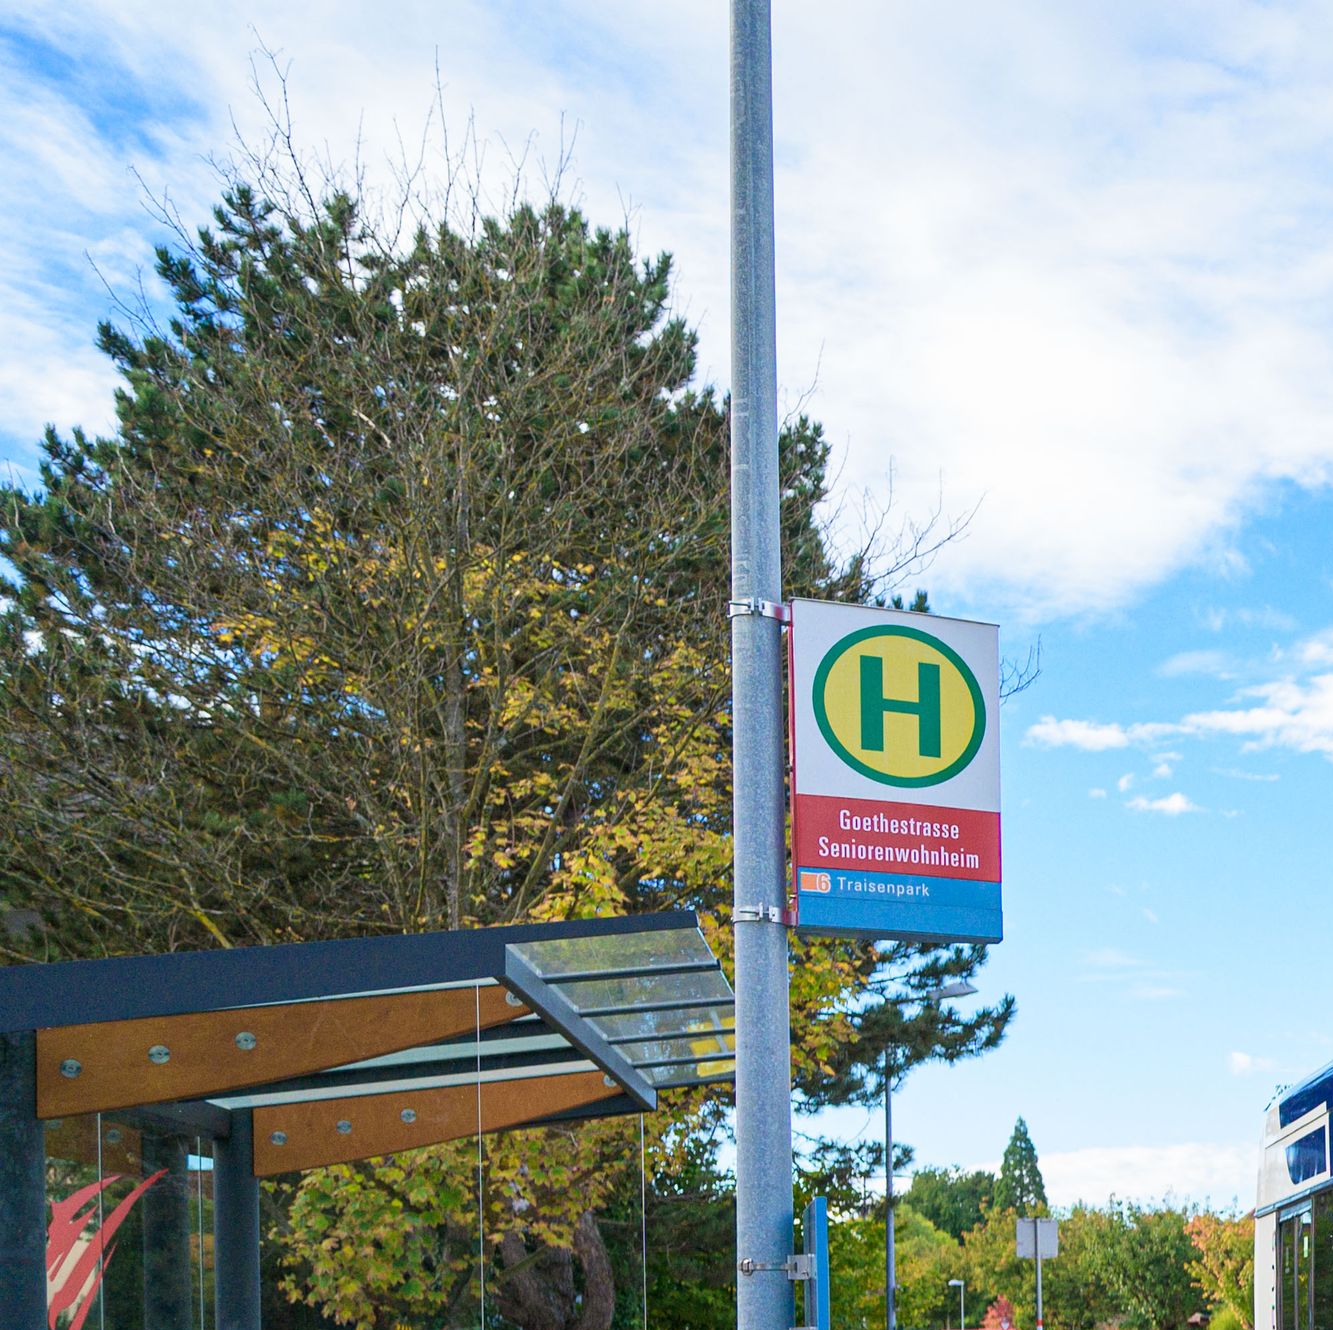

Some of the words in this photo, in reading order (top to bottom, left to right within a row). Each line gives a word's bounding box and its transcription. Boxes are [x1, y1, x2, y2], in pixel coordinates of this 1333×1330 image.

[860, 655, 941, 758] H
[839, 809, 960, 840] Goethestrasse
[818, 837, 980, 869] Seniorenwohnheim
[816, 872, 831, 893] 6
[837, 876, 930, 897] Traisenpark
